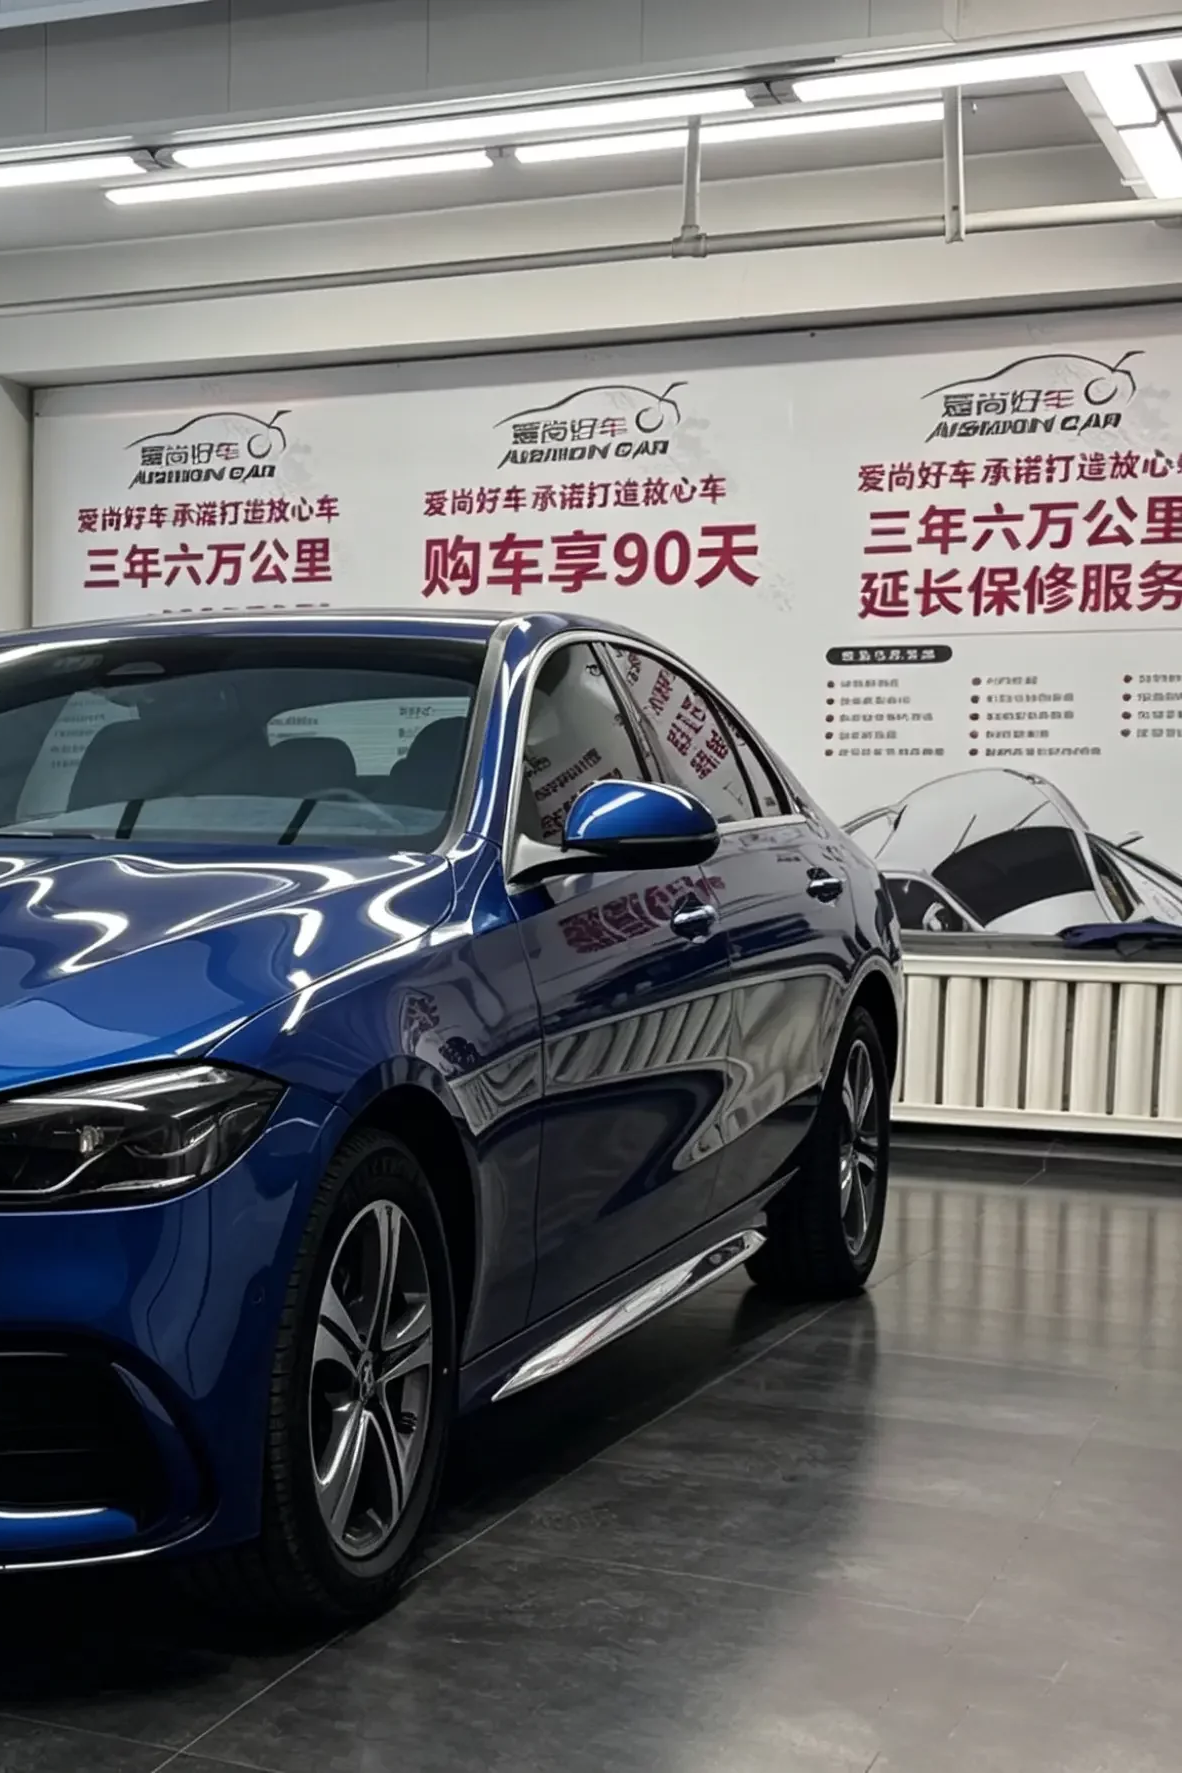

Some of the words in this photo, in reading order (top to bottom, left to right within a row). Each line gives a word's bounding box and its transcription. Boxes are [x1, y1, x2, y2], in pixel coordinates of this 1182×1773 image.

[864, 495, 1182, 555] 三年六万公里
[84, 538, 332, 588] 三年六万公里
[421, 524, 761, 598] 购车享90天
[858, 560, 1182, 619] 延长保修服务
